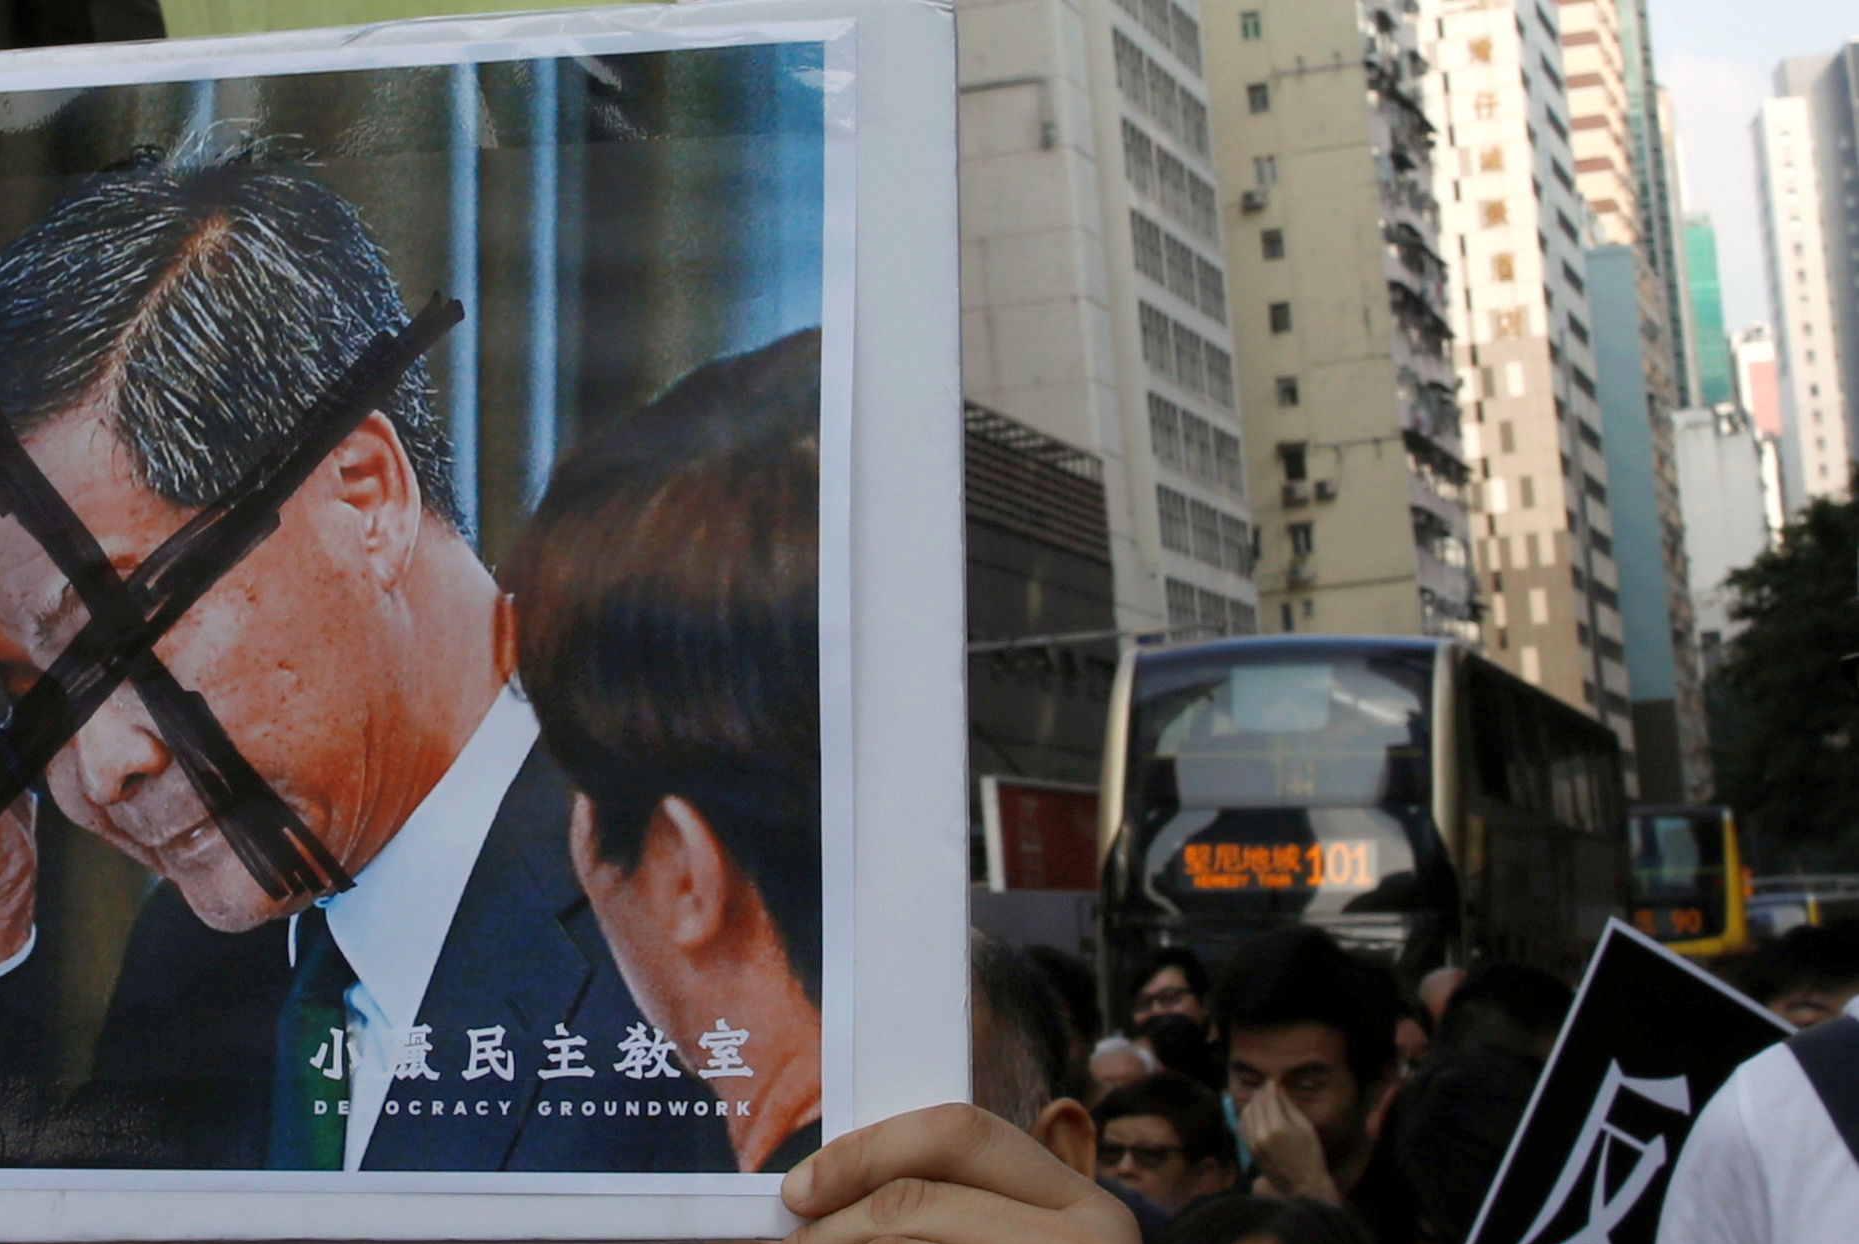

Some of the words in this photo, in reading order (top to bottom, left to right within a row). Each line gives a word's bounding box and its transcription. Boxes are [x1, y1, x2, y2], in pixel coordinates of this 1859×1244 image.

[1305, 842, 1372, 887] 101
[313, 1099, 513, 1117] DEOCRACY
[538, 1099, 753, 1117] GROUNDWORK
